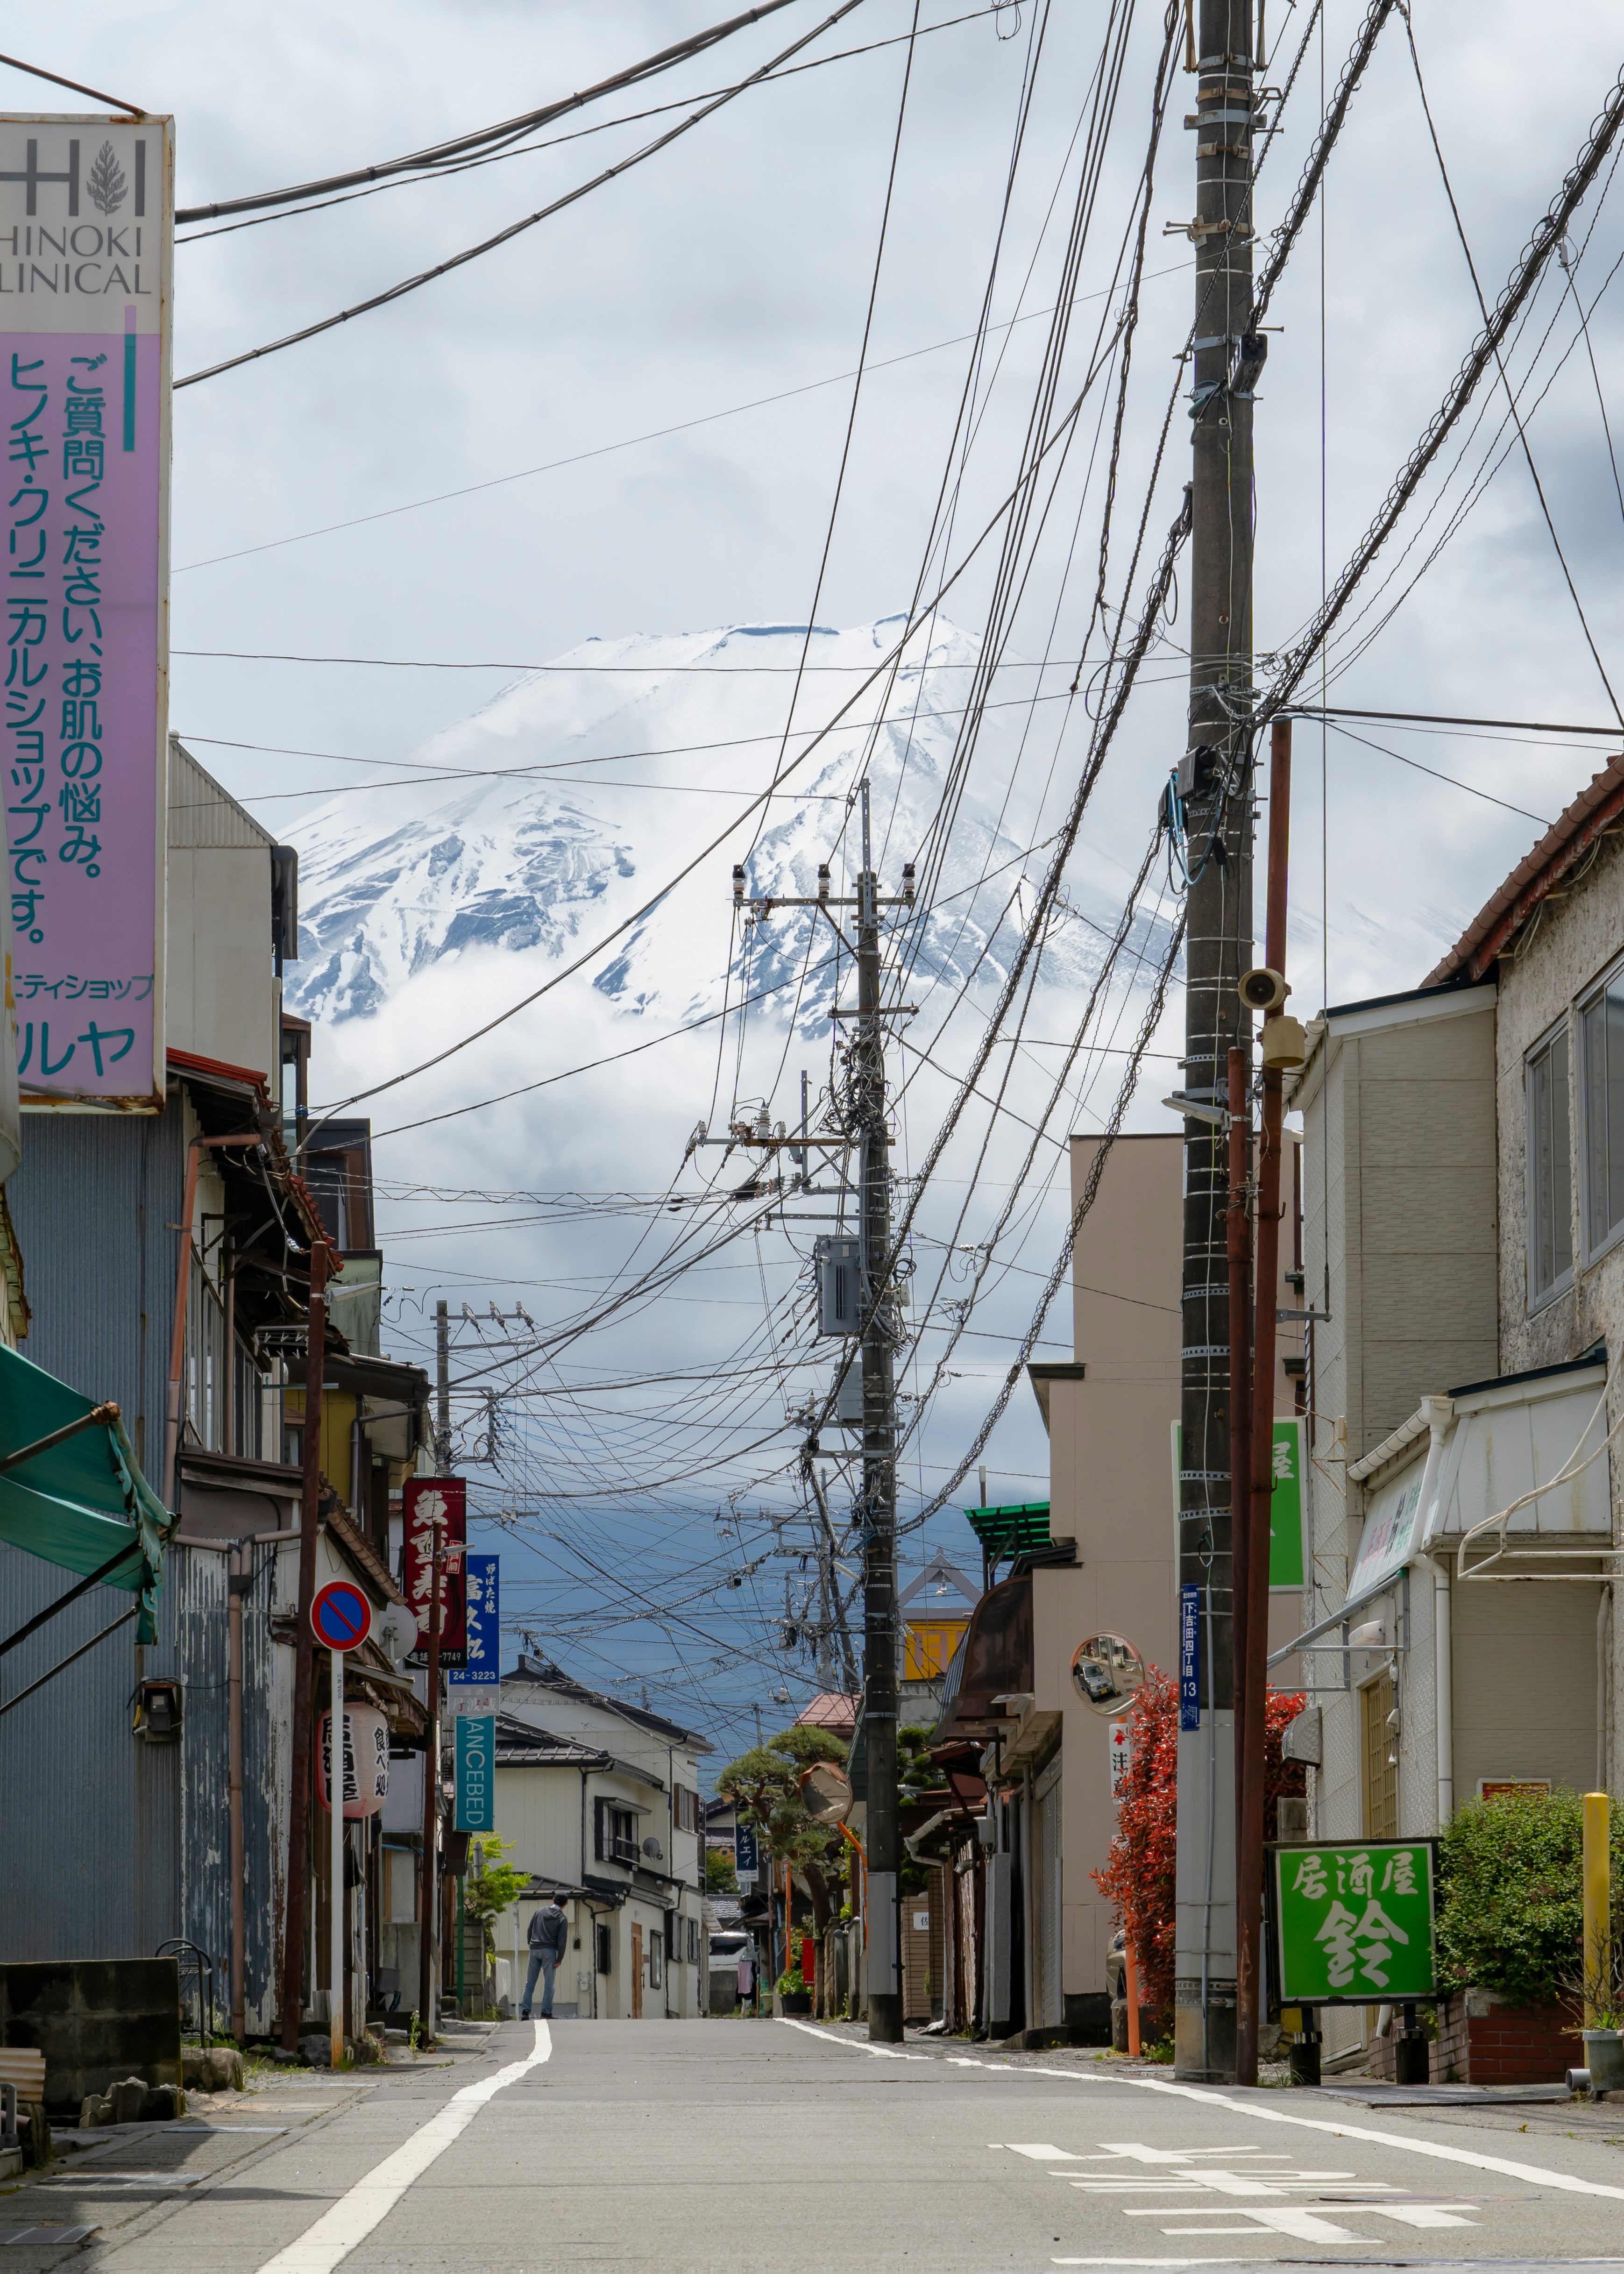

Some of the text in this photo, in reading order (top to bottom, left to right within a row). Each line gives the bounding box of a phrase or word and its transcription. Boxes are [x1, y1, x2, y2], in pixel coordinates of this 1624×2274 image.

[59, 353, 107, 878] ご質問ください、お肌の悩み。
[16, 1021, 135, 1076] ルヤ
[485, 1563, 496, 1613] 炉ばた焼
[410, 1652, 461, 1661] 電話 -7749
[1185, 1602, 1194, 1677] 下吉田四丁目
[453, 1671, 496, 1680] 24-3223
[1183, 1682, 1196, 1697] 13
[375, 1727, 386, 1797] 食べ処
[1291, 1851, 1418, 1899] 居酒屋
[1313, 1899, 1409, 1988] 鈴
